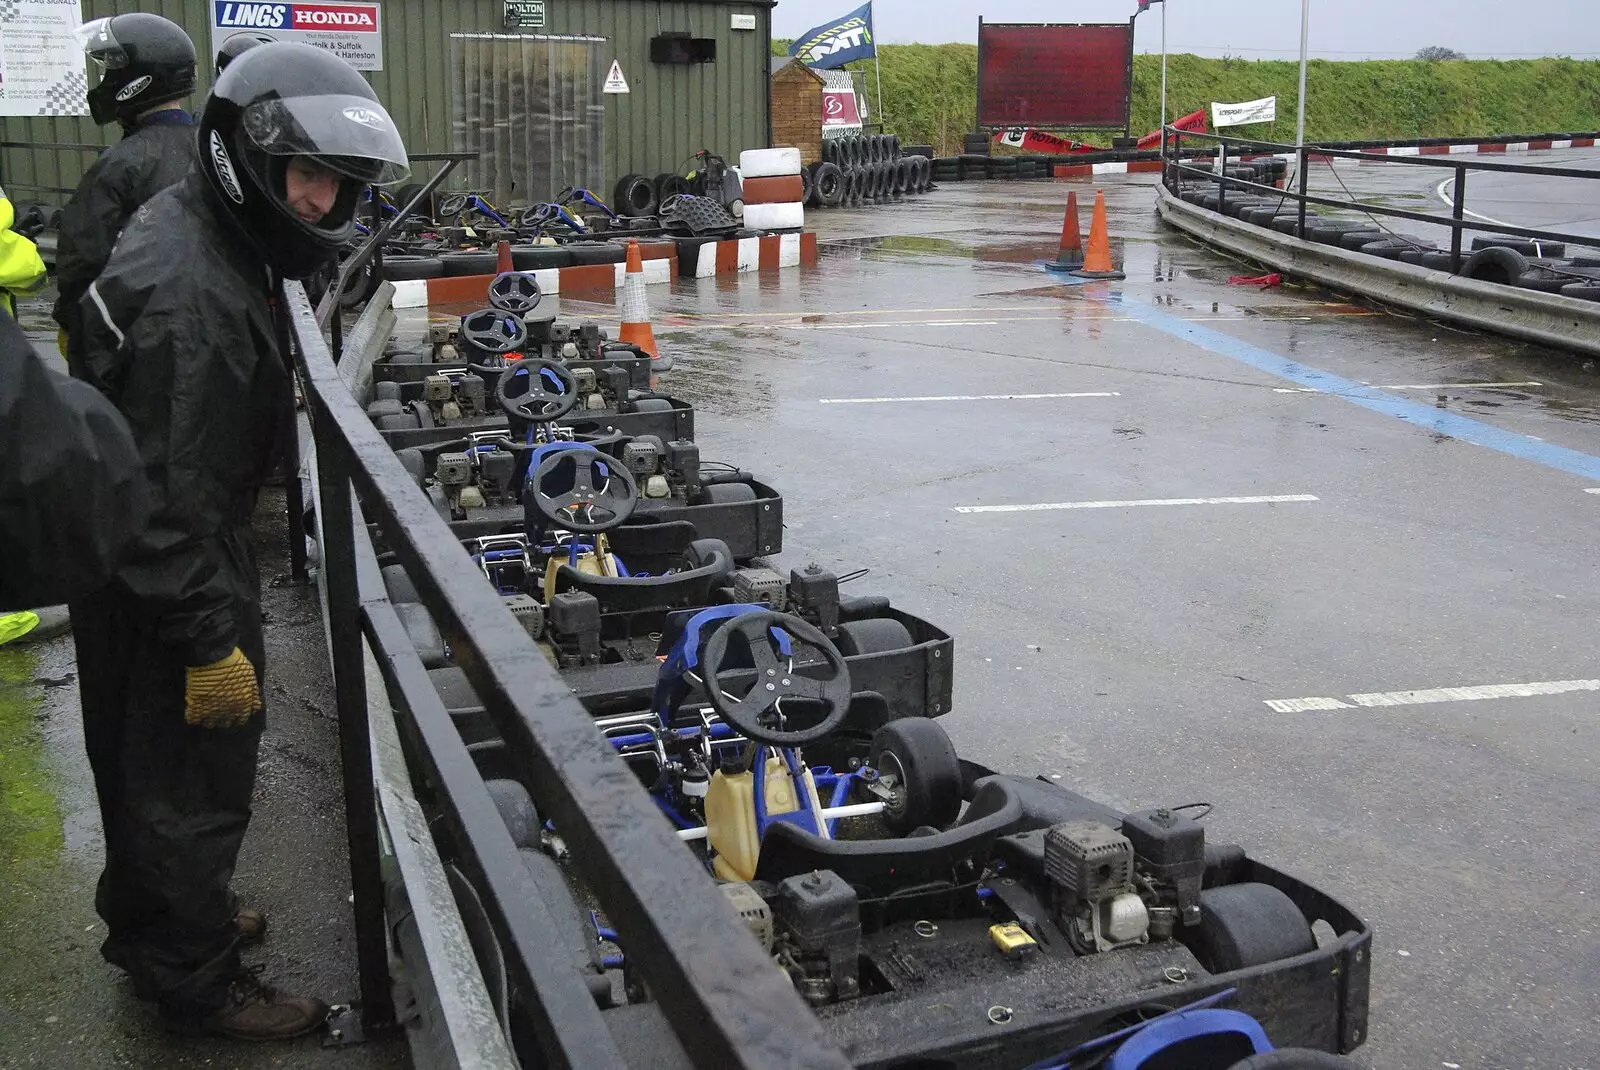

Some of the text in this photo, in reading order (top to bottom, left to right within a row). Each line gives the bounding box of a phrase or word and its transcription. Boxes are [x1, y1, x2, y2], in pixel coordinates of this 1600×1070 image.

[221, 4, 374, 27] LINGS HONDA
[330, 42, 335, 50] &
[337, 42, 362, 50] Suffolk
[342, 52, 376, 60] Harleston
